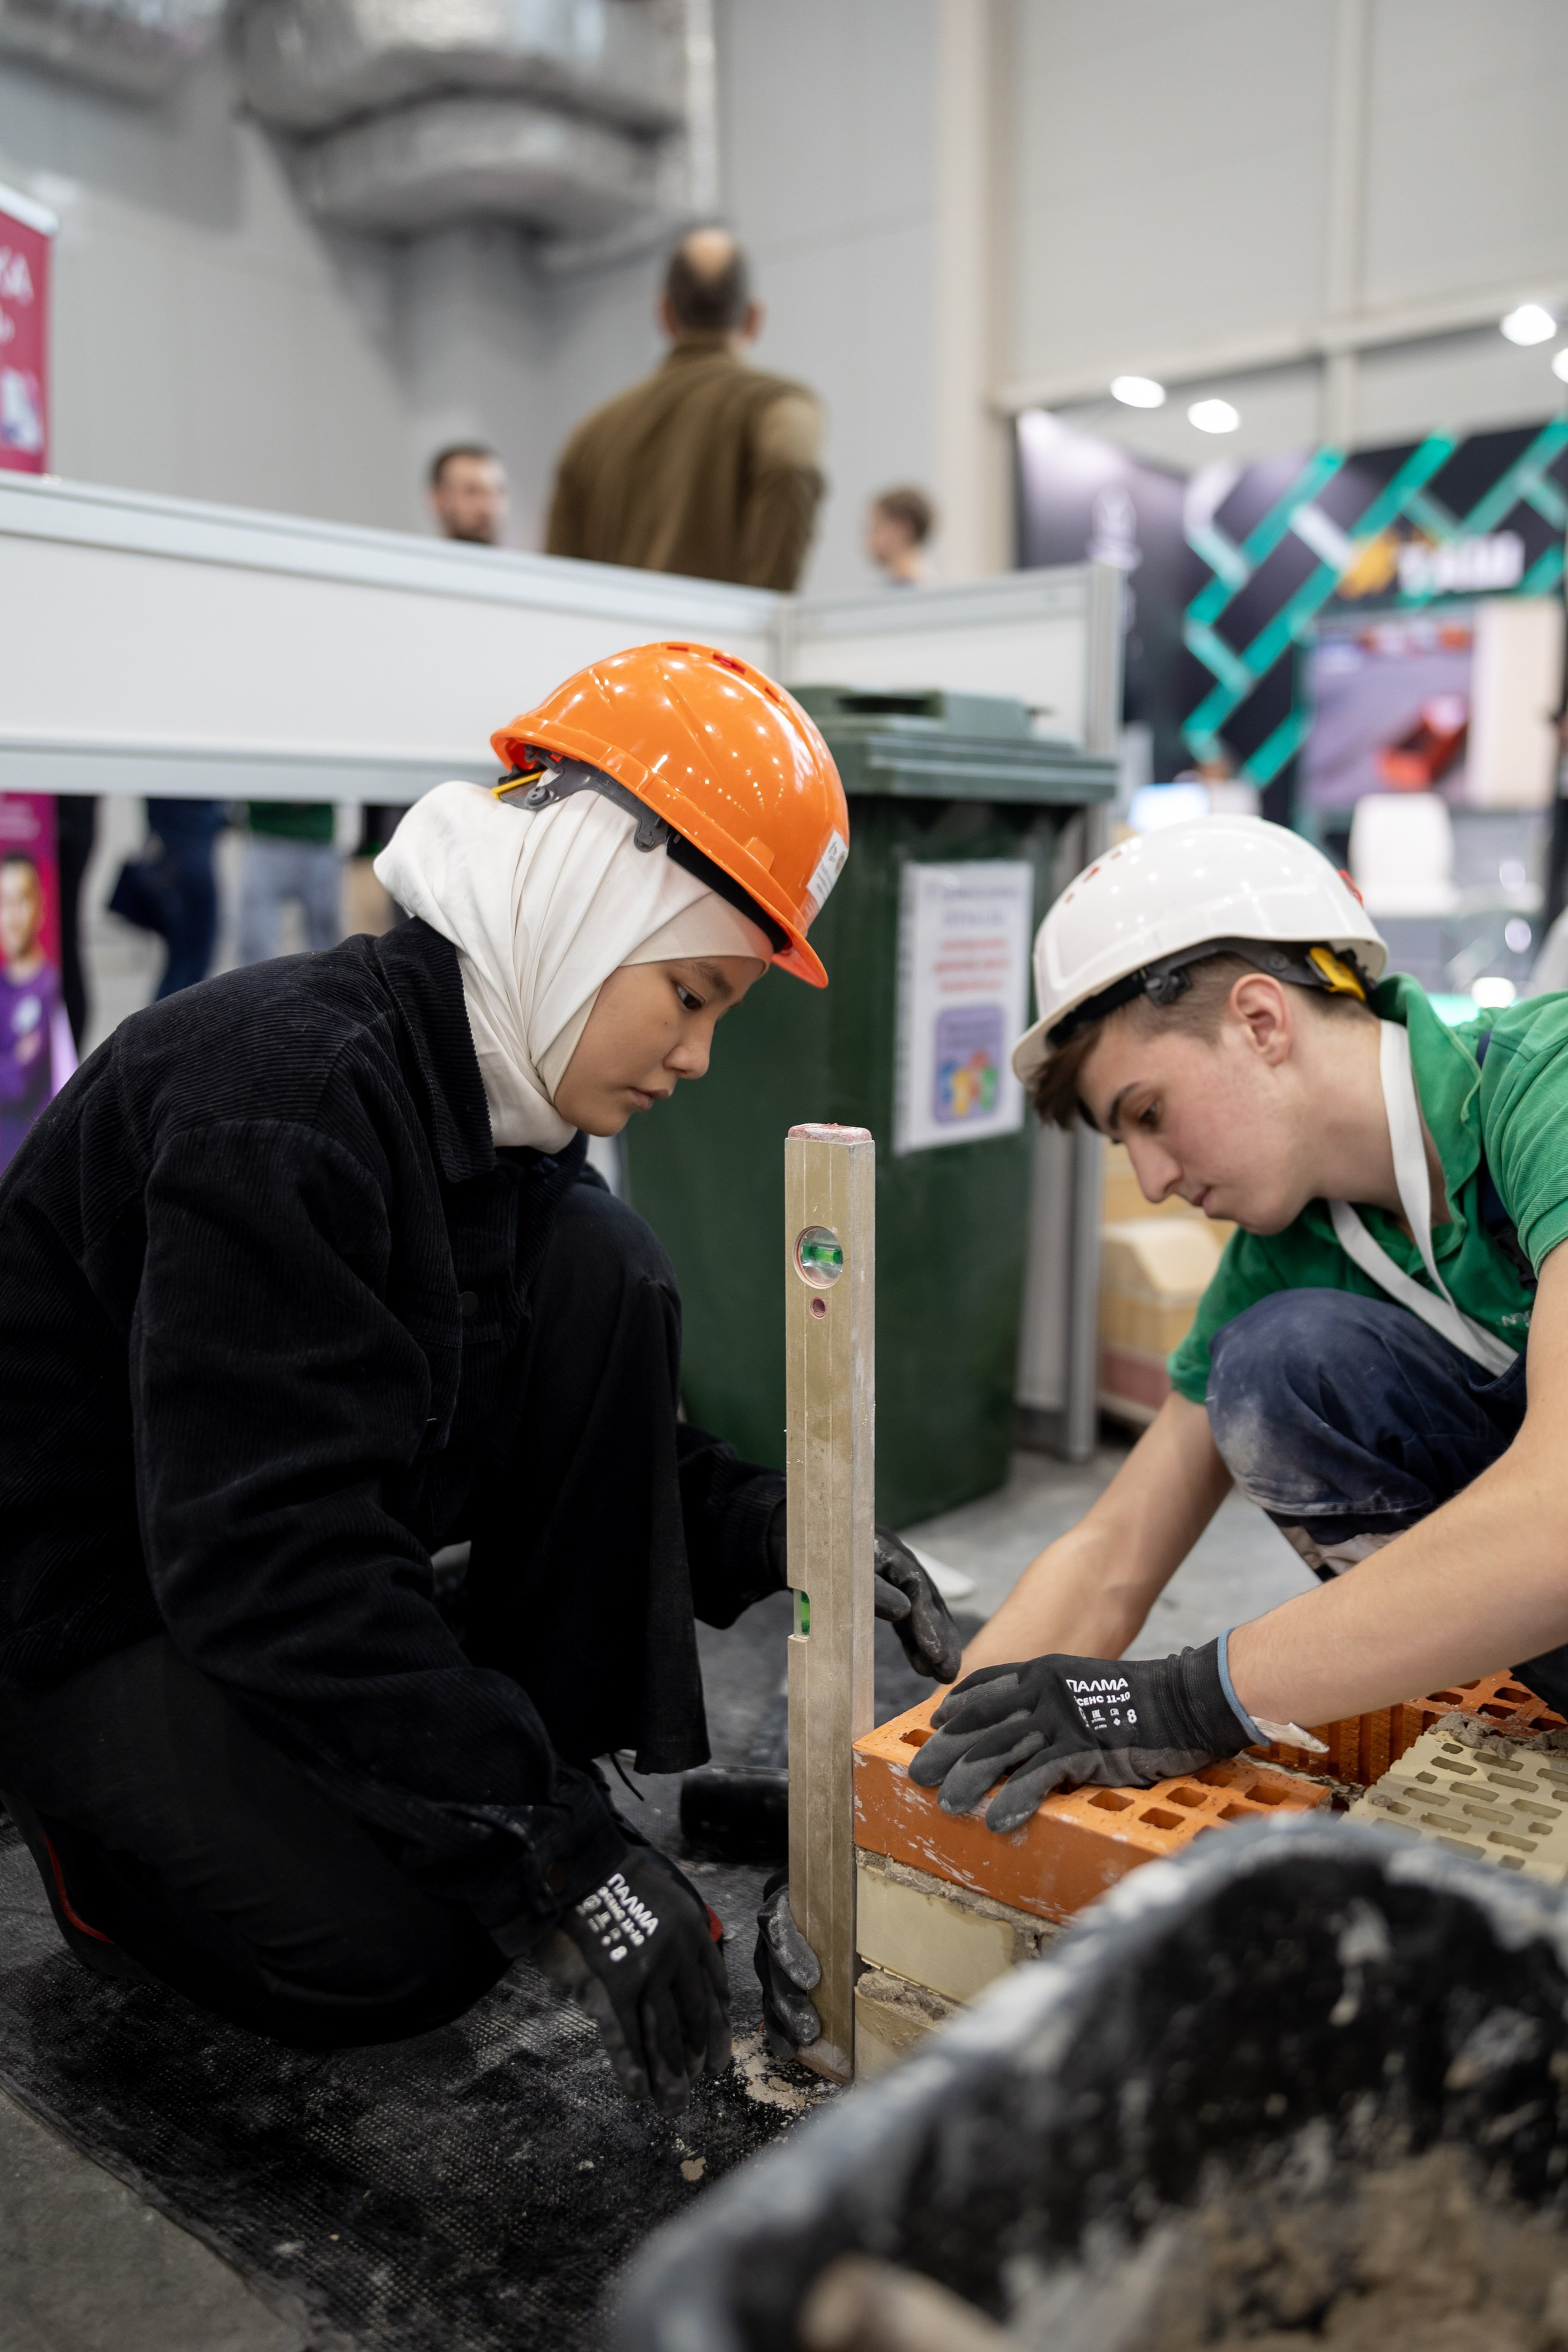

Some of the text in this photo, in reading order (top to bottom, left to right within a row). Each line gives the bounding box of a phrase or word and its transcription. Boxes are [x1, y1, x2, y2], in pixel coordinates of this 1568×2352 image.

[1066, 1678, 1129, 1692] ПАЛМА
[1073, 1691, 1131, 1706] СЕНС 11-10
[1126, 1709, 1137, 1724] 8
[607, 1873, 658, 1936] ПАЛМА
[620, 1918, 644, 1947] 11-10
